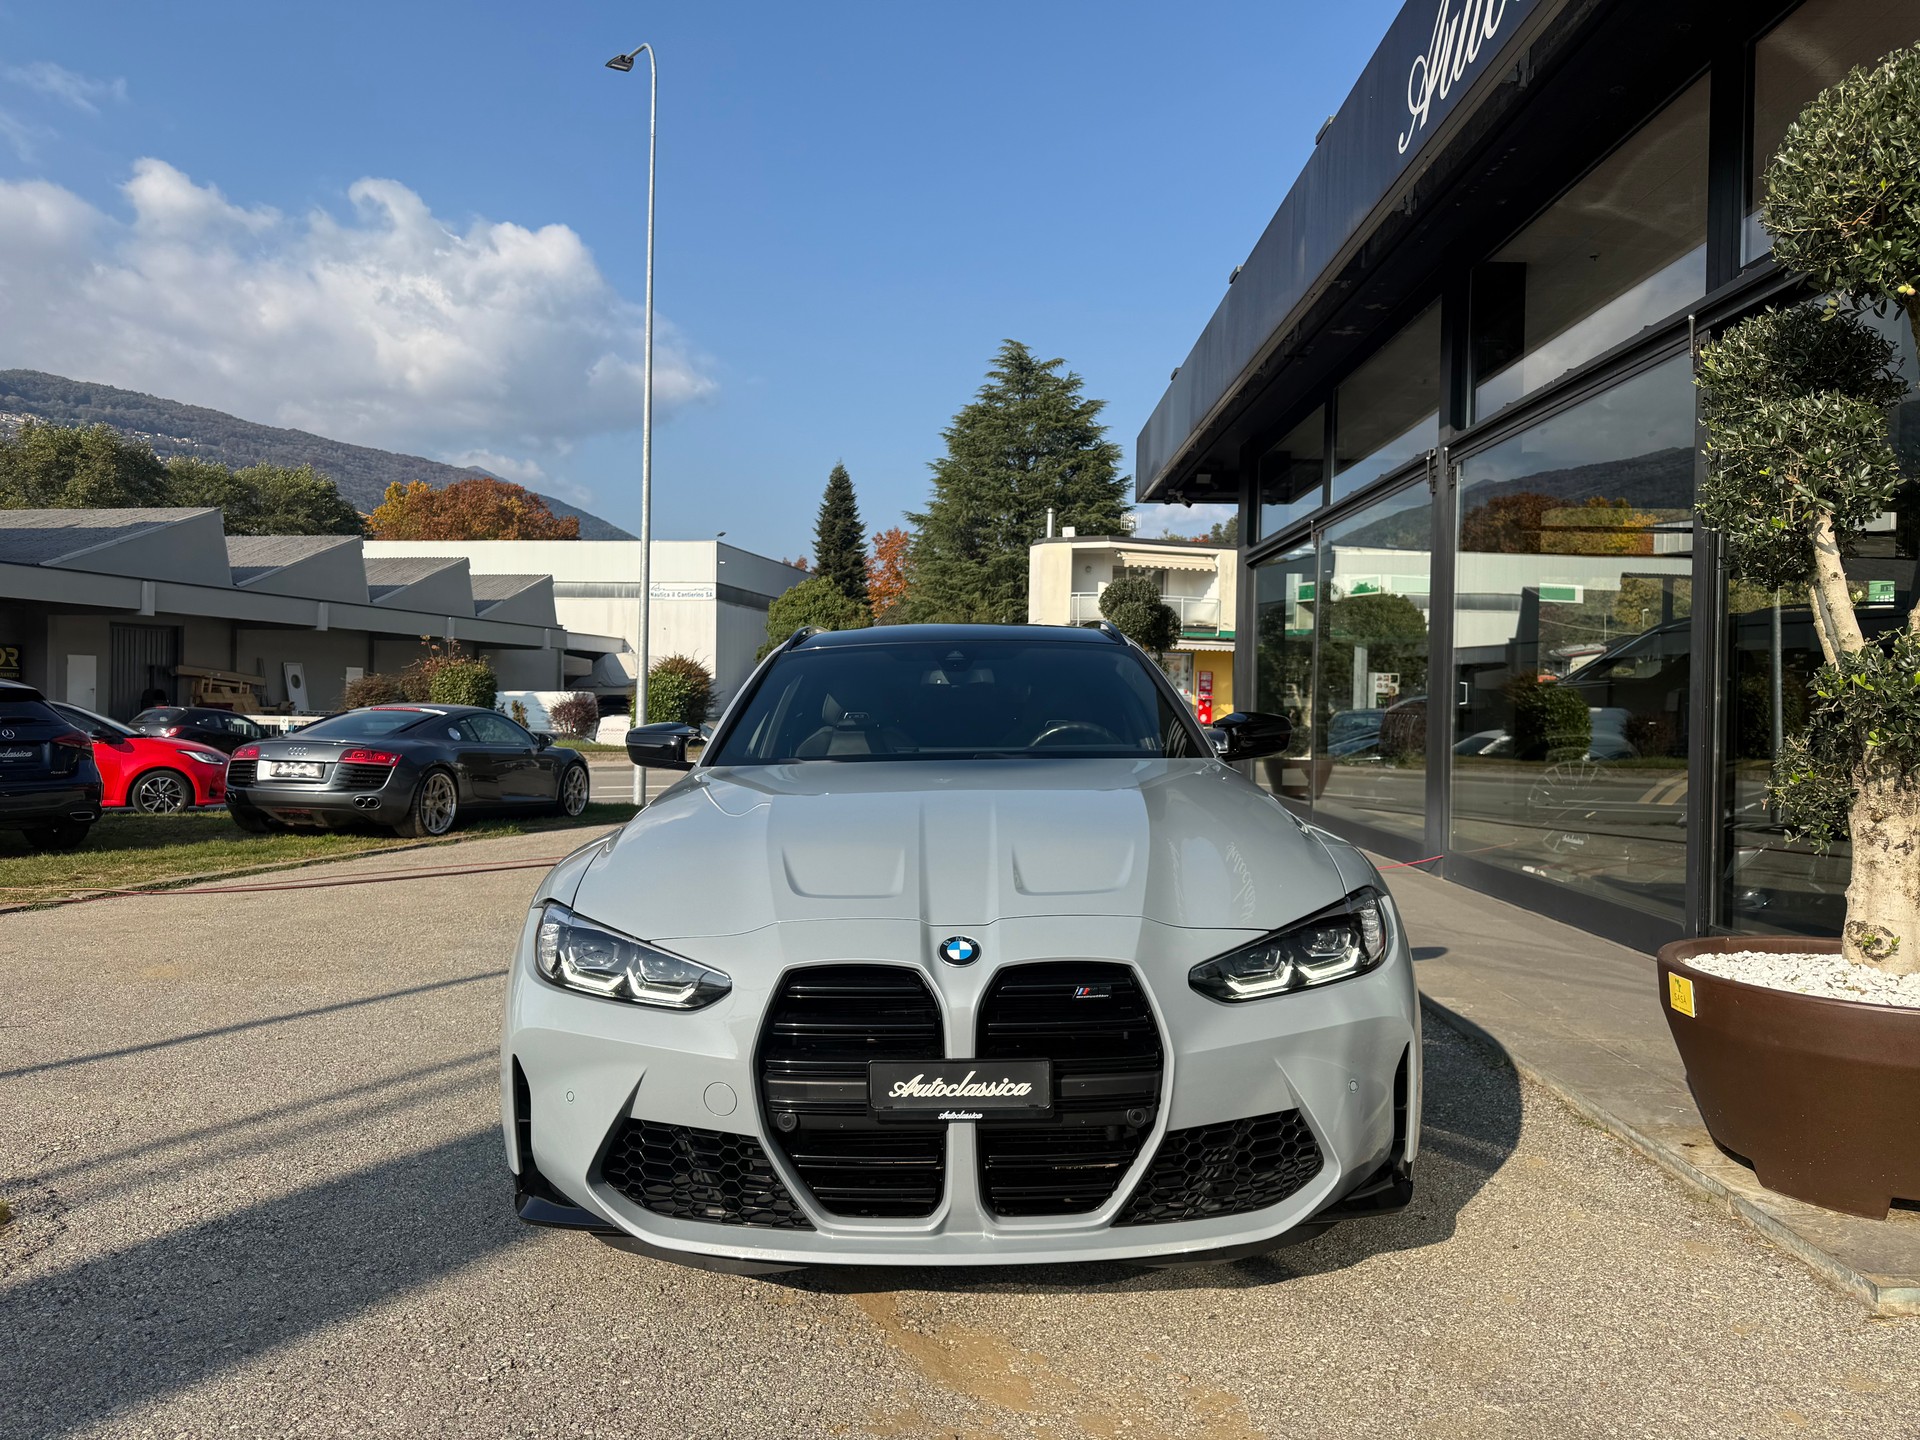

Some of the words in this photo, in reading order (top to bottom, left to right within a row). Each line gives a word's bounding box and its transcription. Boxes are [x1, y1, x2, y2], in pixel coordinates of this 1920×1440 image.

[943, 936, 977, 946] BMW
[888, 1070, 1033, 1098] Autoclassica
[937, 1110, 984, 1120] Autoclassica
